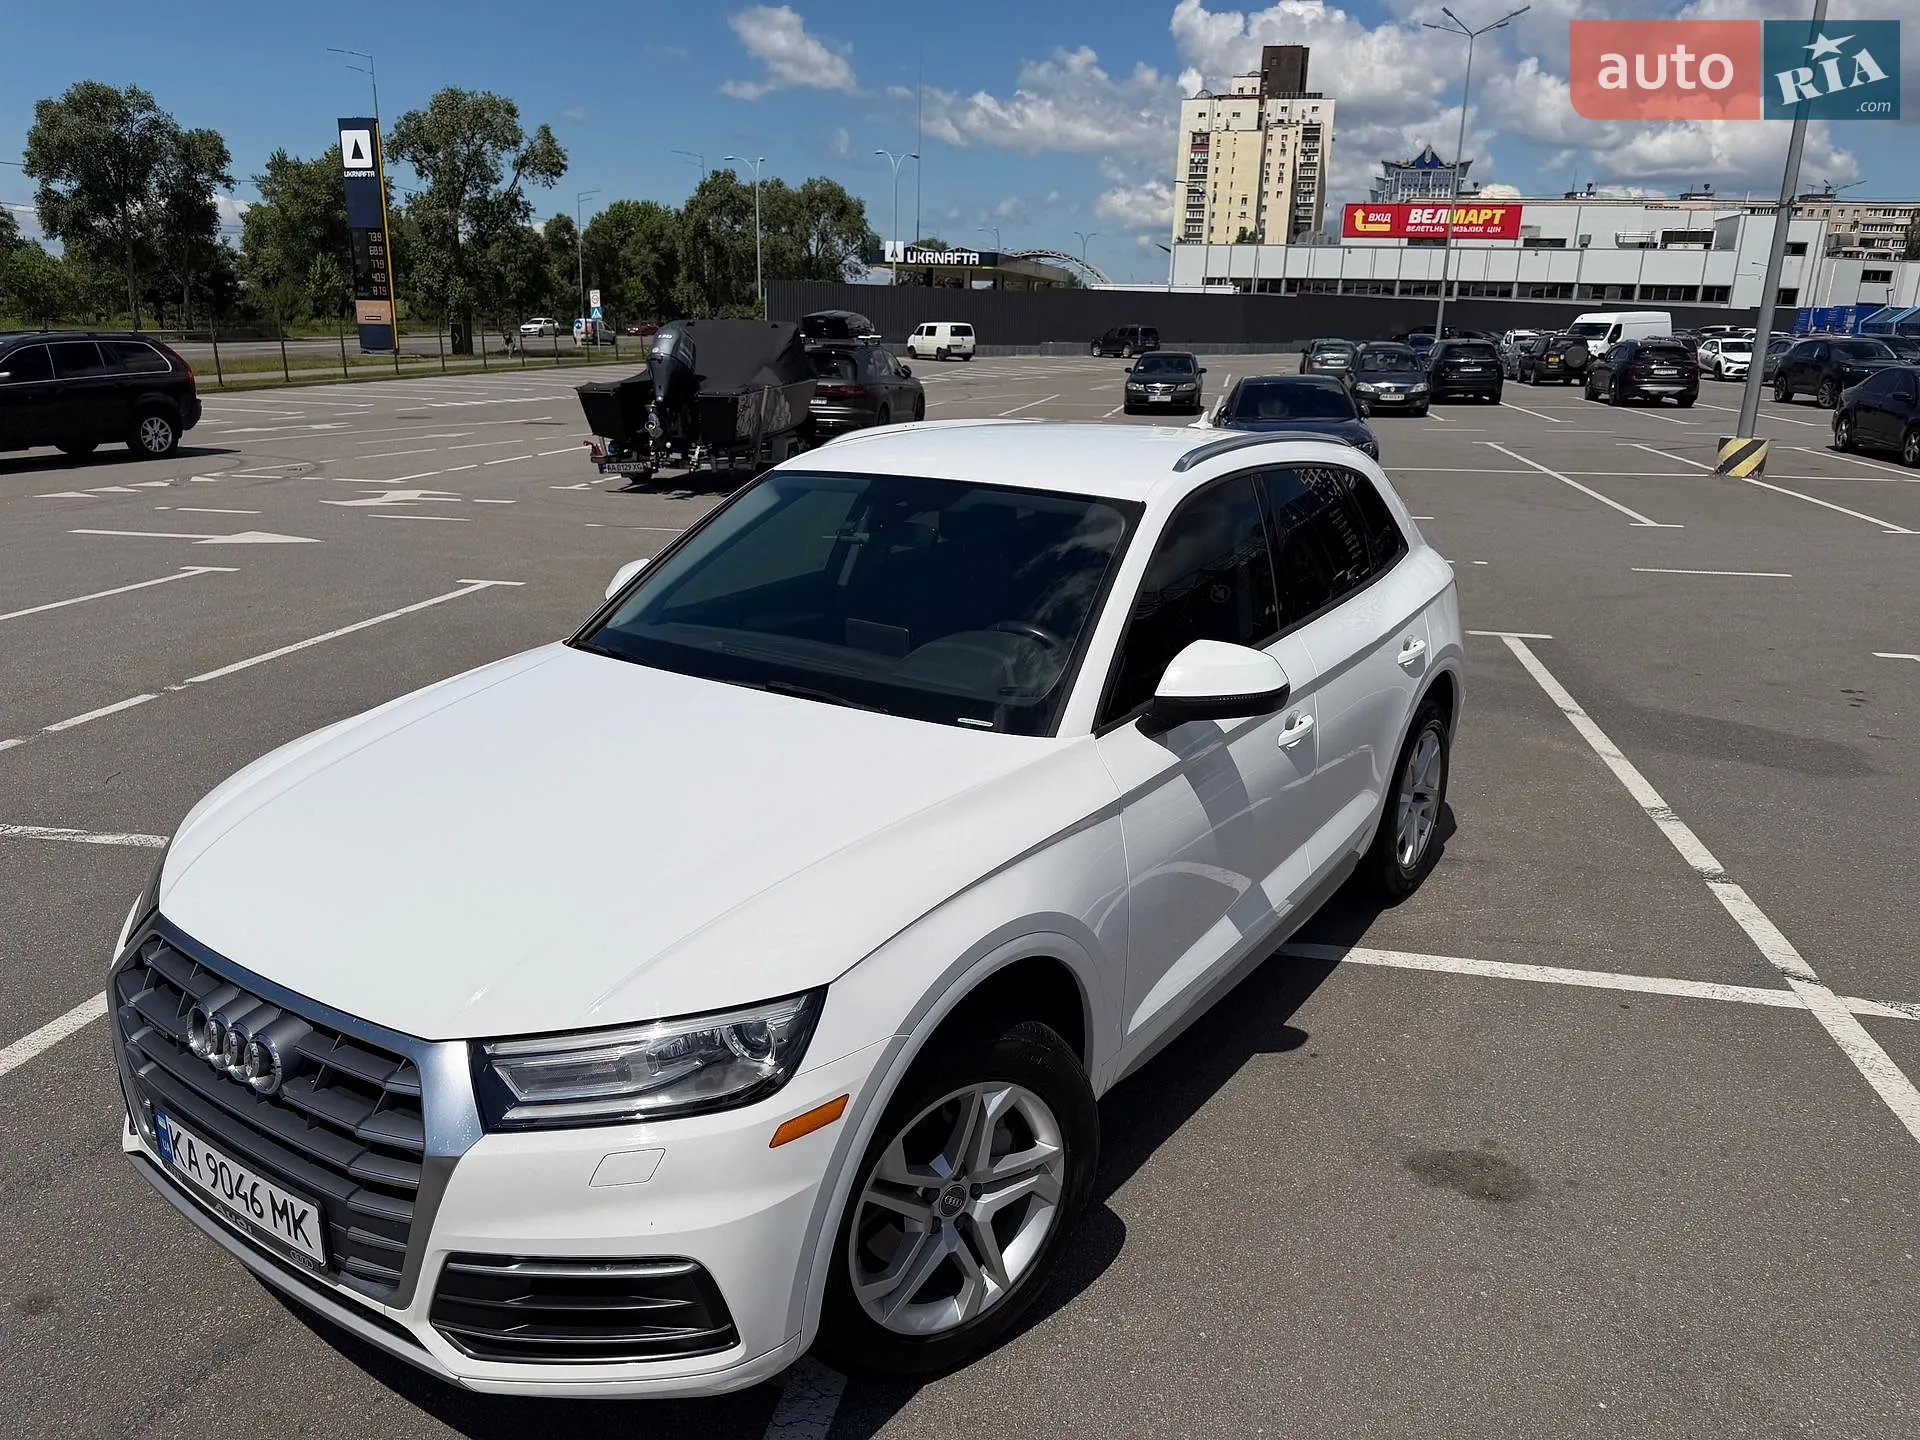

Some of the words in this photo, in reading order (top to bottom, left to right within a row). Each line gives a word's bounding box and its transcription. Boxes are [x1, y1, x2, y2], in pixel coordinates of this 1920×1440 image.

[343, 170, 375, 178] UKRNAFTA
[1368, 213, 1391, 222] ВХІД
[1408, 208, 1506, 225] ВЕЛМАРТ
[906, 251, 980, 265] UKRNAFTA
[169, 1123, 203, 1180] KA
[205, 1152, 264, 1219] 9046
[269, 1190, 313, 1249] MK
